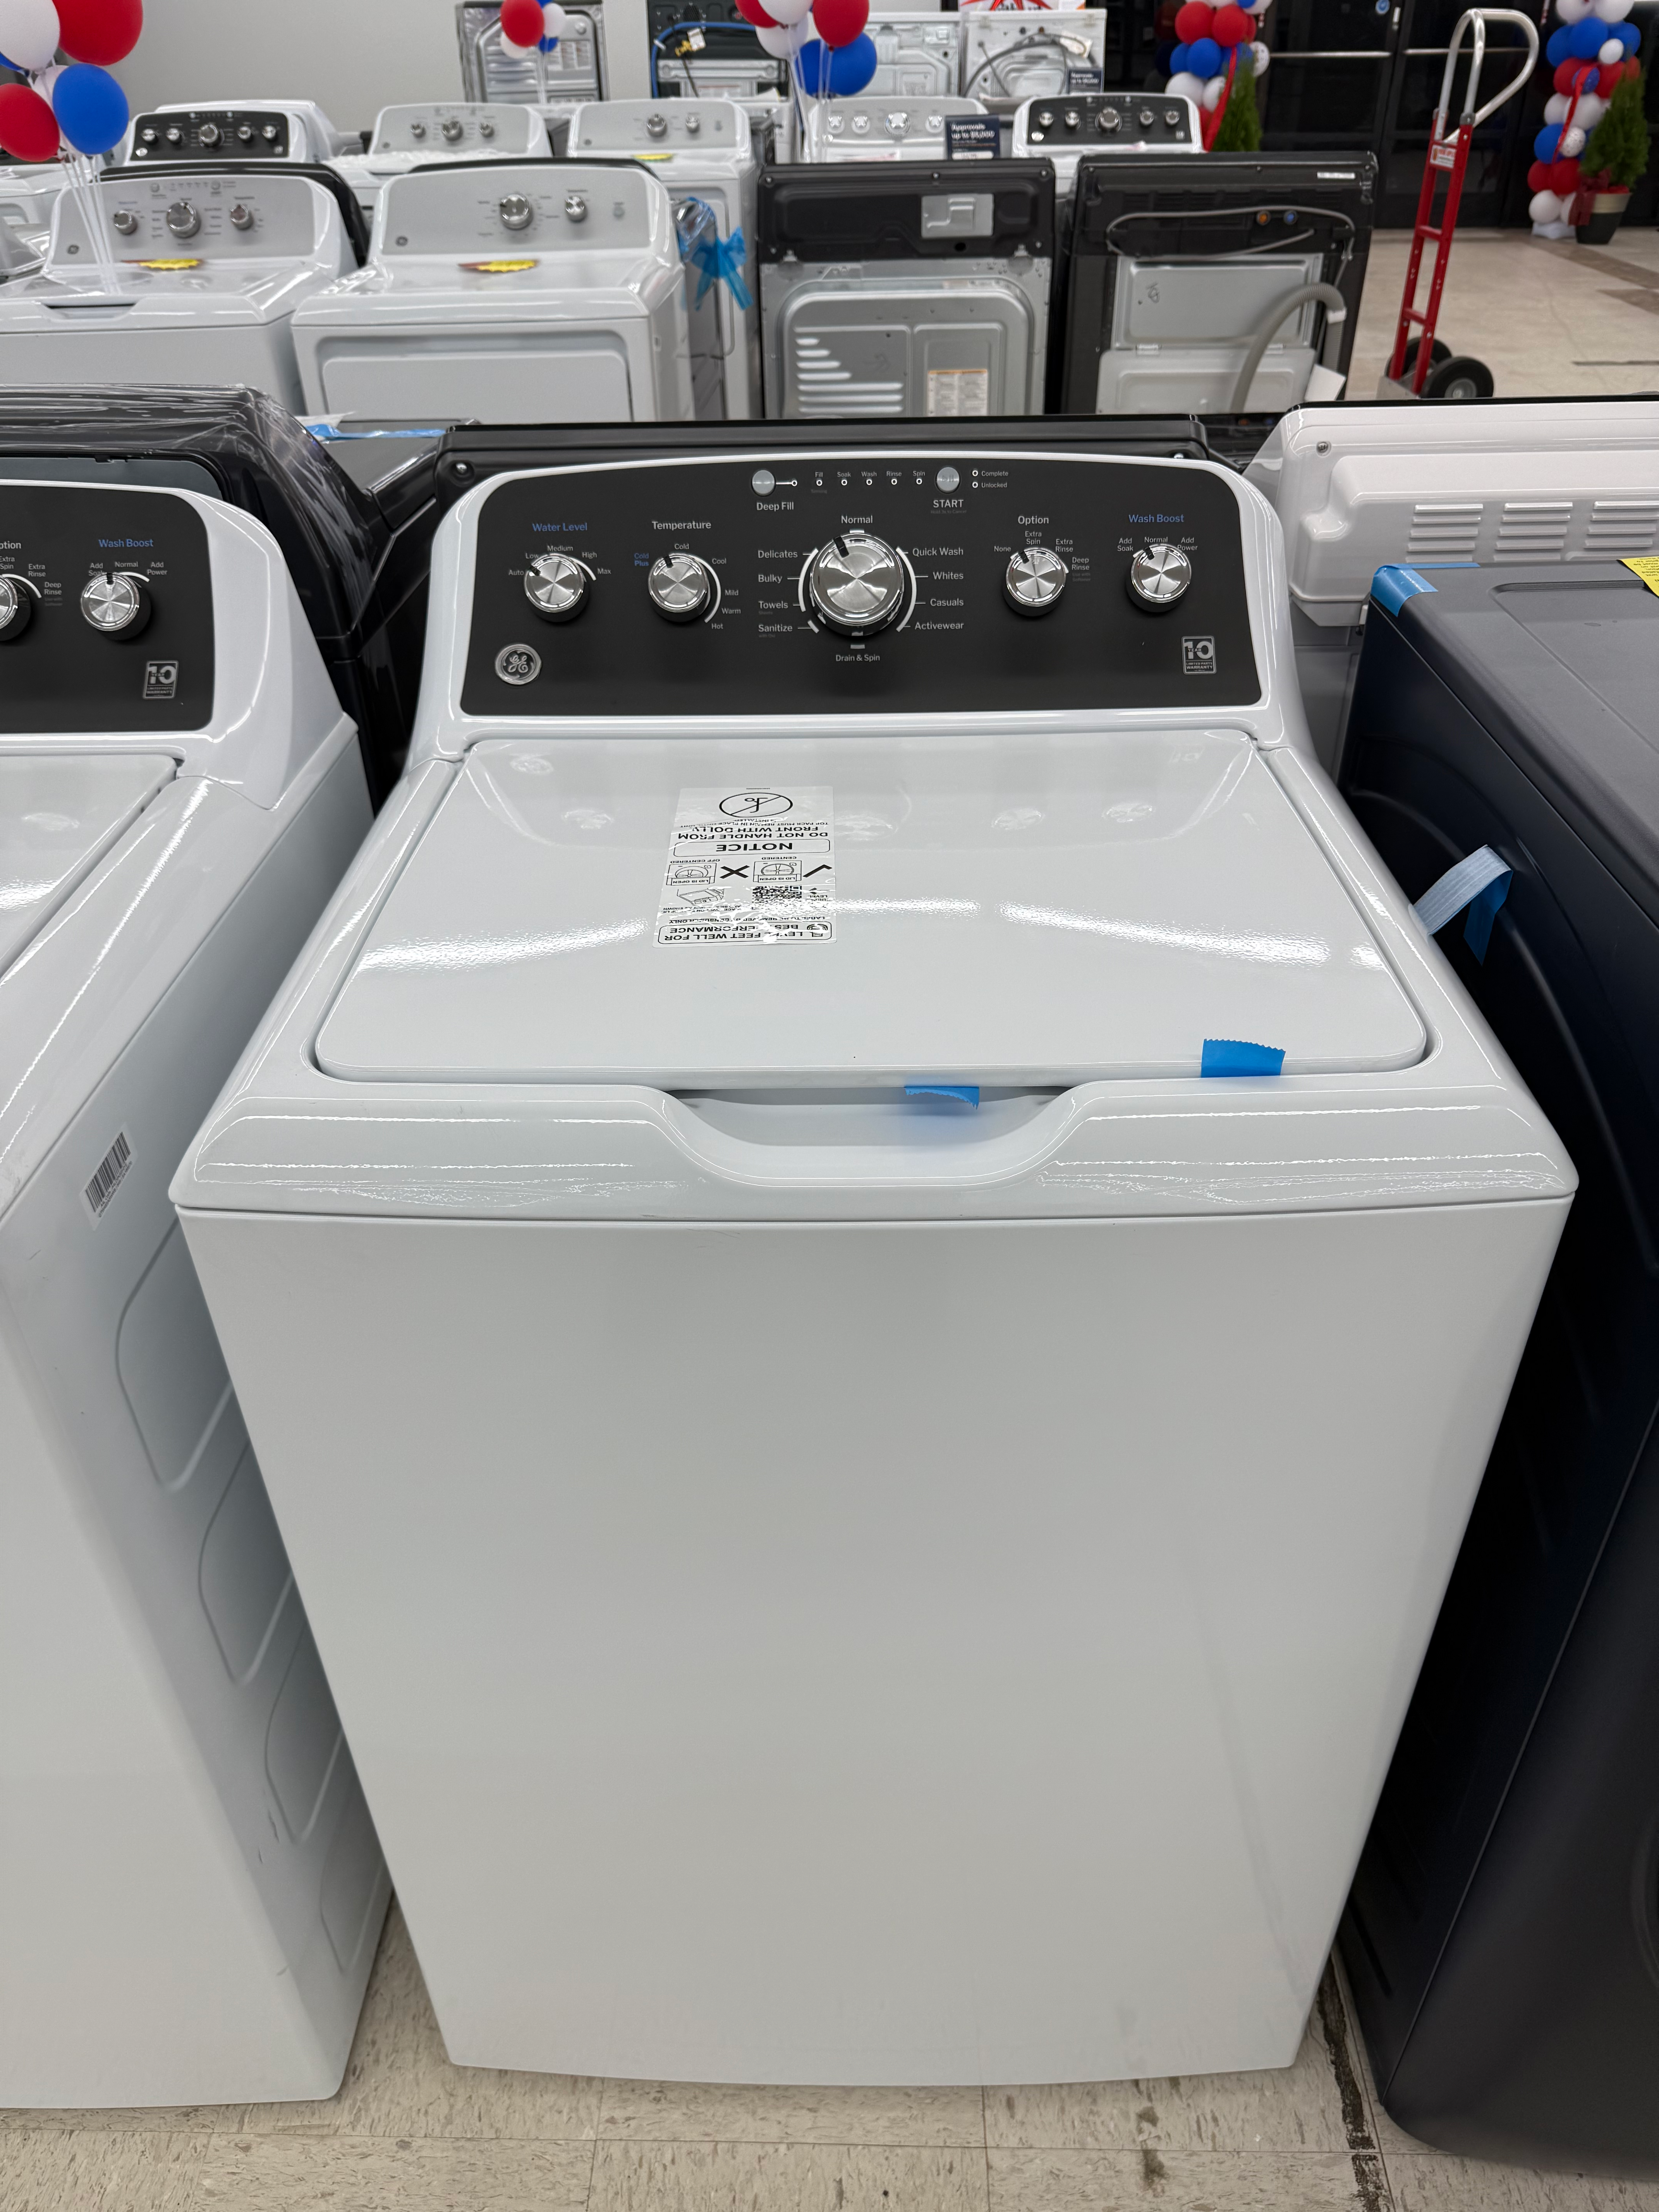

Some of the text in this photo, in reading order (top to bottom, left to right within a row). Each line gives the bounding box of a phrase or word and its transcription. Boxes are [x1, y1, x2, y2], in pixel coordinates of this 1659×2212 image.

[756, 501, 794, 512] Deep Fill
[933, 499, 963, 508] START
[841, 515, 872, 524] Normal
[1018, 515, 1049, 526] Option
[1128, 514, 1184, 522] Wash Boost
[532, 522, 587, 532] Water Level
[651, 521, 711, 531] Temperature
[0, 541, 21, 550] ption
[98, 539, 154, 547] Wash Boost
[758, 550, 798, 558] Delicates
[912, 547, 963, 557] Quick Wash
[758, 574, 783, 584] Bulky
[933, 571, 964, 580] Whites
[758, 601, 788, 609] Towels
[930, 598, 964, 606] Casuals
[758, 624, 793, 632] Sanitize
[915, 621, 964, 630] Activewear
[1184, 641, 1213, 659] 10
[864, 654, 880, 662] Spin
[148, 666, 176, 684] 10
[716, 843, 792, 852] NOTICE
